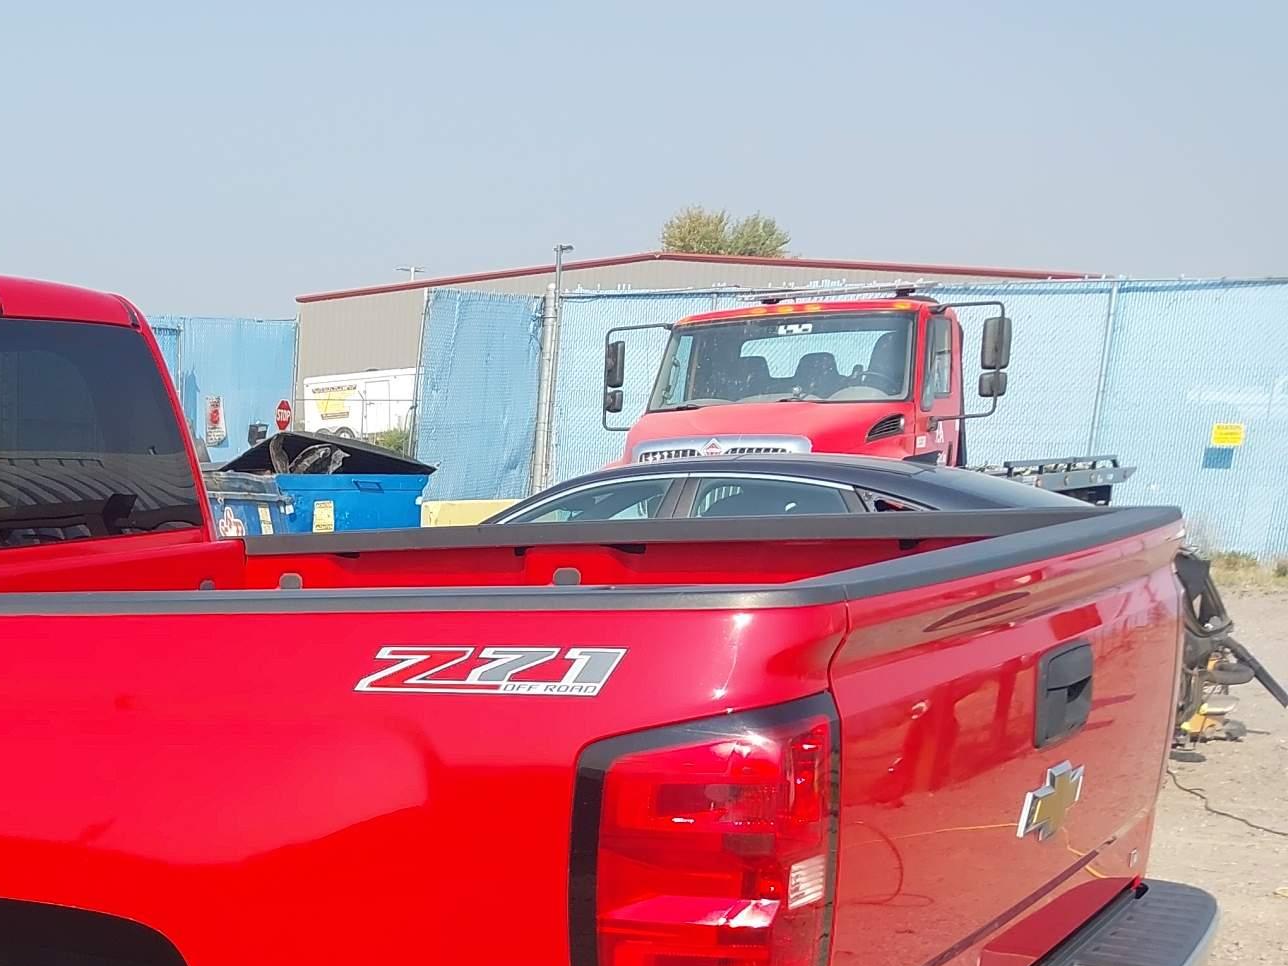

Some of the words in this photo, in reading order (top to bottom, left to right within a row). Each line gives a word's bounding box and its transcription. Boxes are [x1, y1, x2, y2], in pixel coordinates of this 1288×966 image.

[277, 409, 291, 421] STOP
[353, 645, 629, 694] Z71
[503, 683, 539, 693] OFF
[543, 684, 598, 694] ROAD
